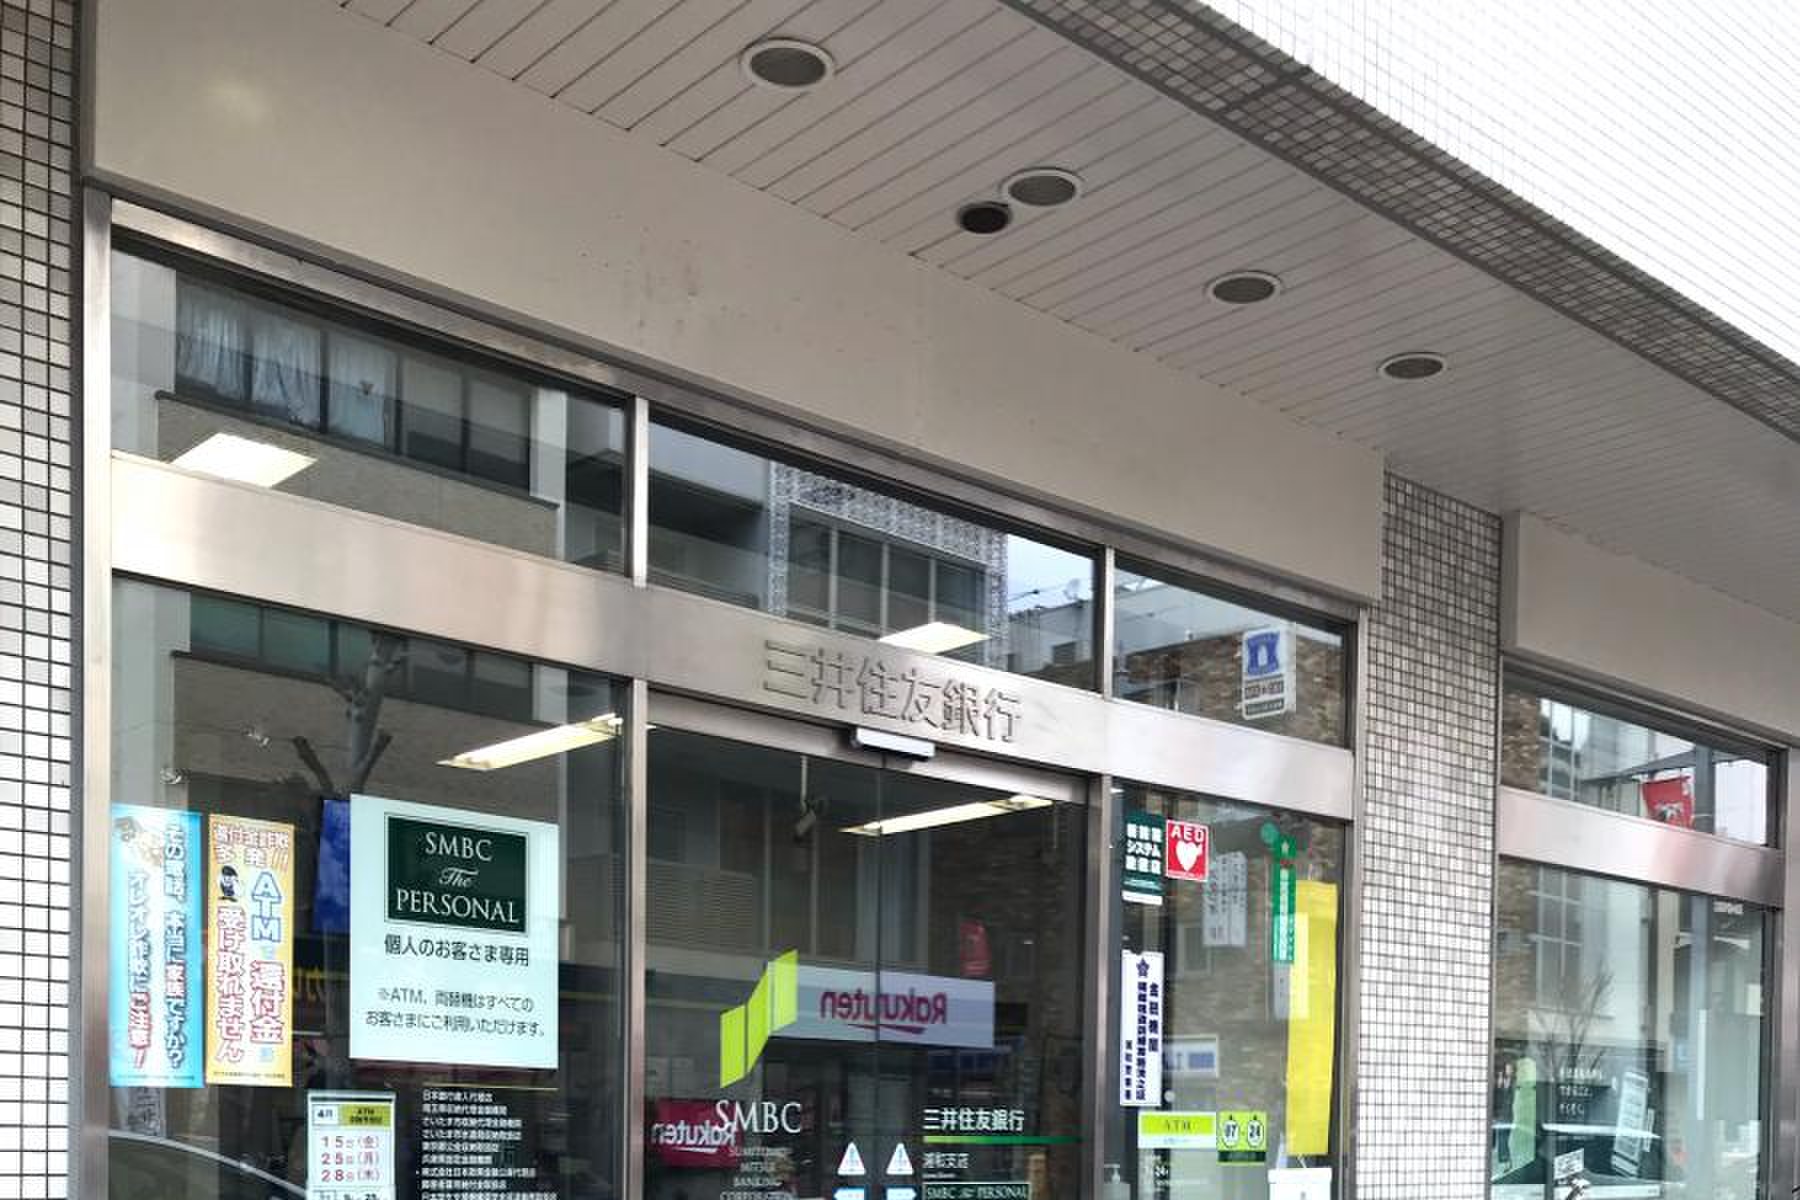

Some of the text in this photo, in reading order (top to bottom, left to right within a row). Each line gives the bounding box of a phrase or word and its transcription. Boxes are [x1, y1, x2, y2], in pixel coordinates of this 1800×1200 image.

[763, 639, 1021, 743] 三井住友銀行
[425, 832, 493, 861] SMBC
[1171, 824, 1205, 842] AED
[439, 867, 478, 888] The
[395, 888, 519, 923] PERSONAL
[384, 934, 529, 966] 個人のお客さま専用
[365, 1010, 544, 1037] お客さまにご利用いただけます。
[716, 1100, 801, 1133] SMBC
[923, 1107, 1024, 1131] 三井住友銀行
